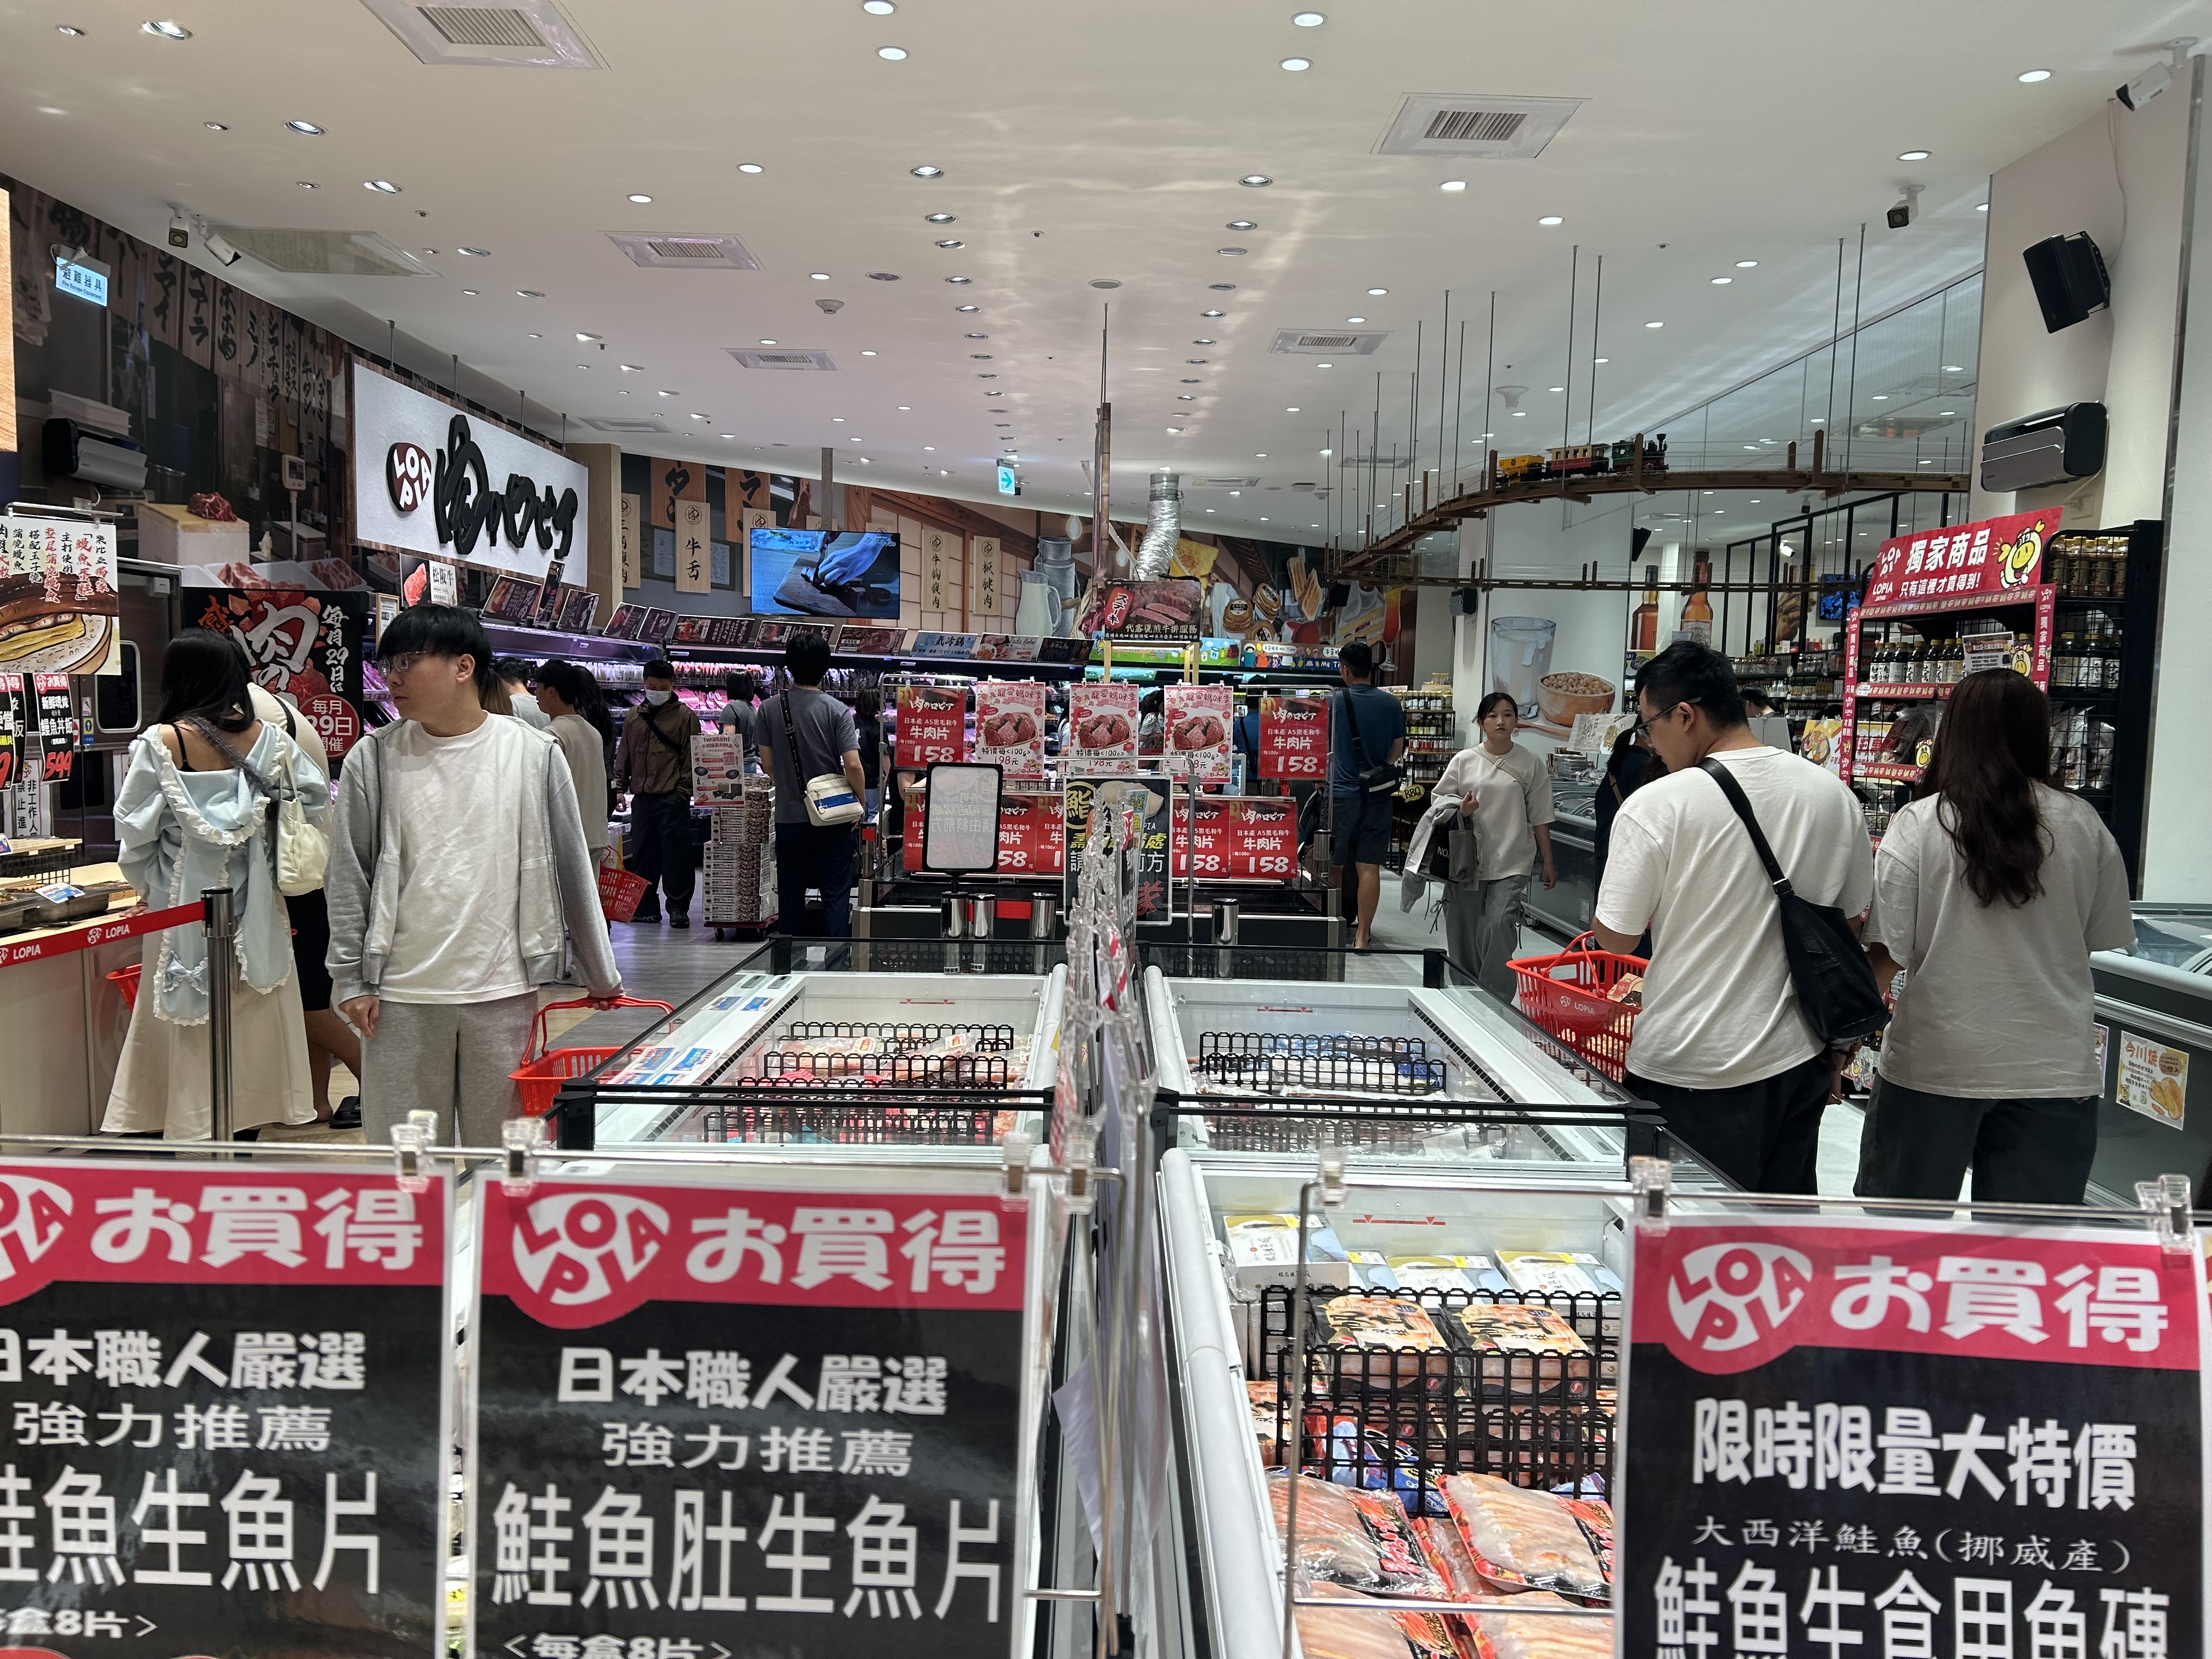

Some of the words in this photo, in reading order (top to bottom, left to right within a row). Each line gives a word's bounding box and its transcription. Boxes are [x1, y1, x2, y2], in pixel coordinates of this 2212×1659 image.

[70, 283, 82, 292] Escape
[83, 288, 101, 300] Equipment
[12, 528, 25, 571] 蒲燒鰻魚
[29, 529, 43, 583] 搭配玉子燒
[61, 532, 74, 574] 主打使用
[1905, 528, 1991, 575] 獨家商品
[685, 536, 702, 581] 牛舌
[1872, 582, 1893, 596] LOPIA
[1107, 592, 1129, 625] ステーキ
[1126, 623, 1198, 634] 代客現煎牛排服務
[2036, 616, 2048, 672] 獨家商品
[997, 687, 1042, 700] 寵愛媽咪季
[1092, 689, 1136, 701] 寵愛媽咪季
[1186, 691, 1230, 703] 寵愛媽咪季
[1846, 685, 1855, 694] 只有
[909, 696, 955, 713] 肉のロピア
[1271, 707, 1317, 724] 肉のロピア
[41, 717, 73, 736] 鰻魚丼飯
[910, 725, 950, 740] 牛肉片
[1273, 736, 1313, 750] 牛肉片
[914, 745, 955, 762] 158
[995, 755, 1019, 765] 198元
[44, 749, 72, 780] 599
[1183, 759, 1206, 769] 18元
[1277, 756, 1318, 772] 158
[1404, 787, 1421, 799] BBQ
[17, 782, 26, 836] 禁止進
[1175, 805, 1219, 822] 肉ロピア
[1240, 808, 1285, 825] 肉のロピア
[1000, 831, 1023, 844] 肉片
[1176, 834, 1215, 849] 牛肉片
[1243, 837, 1283, 850] 牛肉片
[998, 850, 1028, 867] 58
[1180, 854, 1221, 871] 158
[1249, 856, 1289, 873] 158
[105, 924, 130, 939] LOPIA
[13, 944, 41, 960] LOPIA
[1574, 1002, 1595, 1015] LOPIA
[91, 1186, 426, 1270] お買得
[685, 1207, 1005, 1295] お買得
[1831, 1254, 2168, 1352] お買得
[557, 1347, 948, 1415] 日本職人嚴選
[13, 1403, 332, 1452] 強力推薦
[601, 1421, 915, 1478] 強力推薦
[1692, 1398, 2138, 1513] 限時限量大特價
[490, 1480, 1001, 1623] 鮭魚肚生魚片
[0, 1606, 157, 1638] 盒8片>
